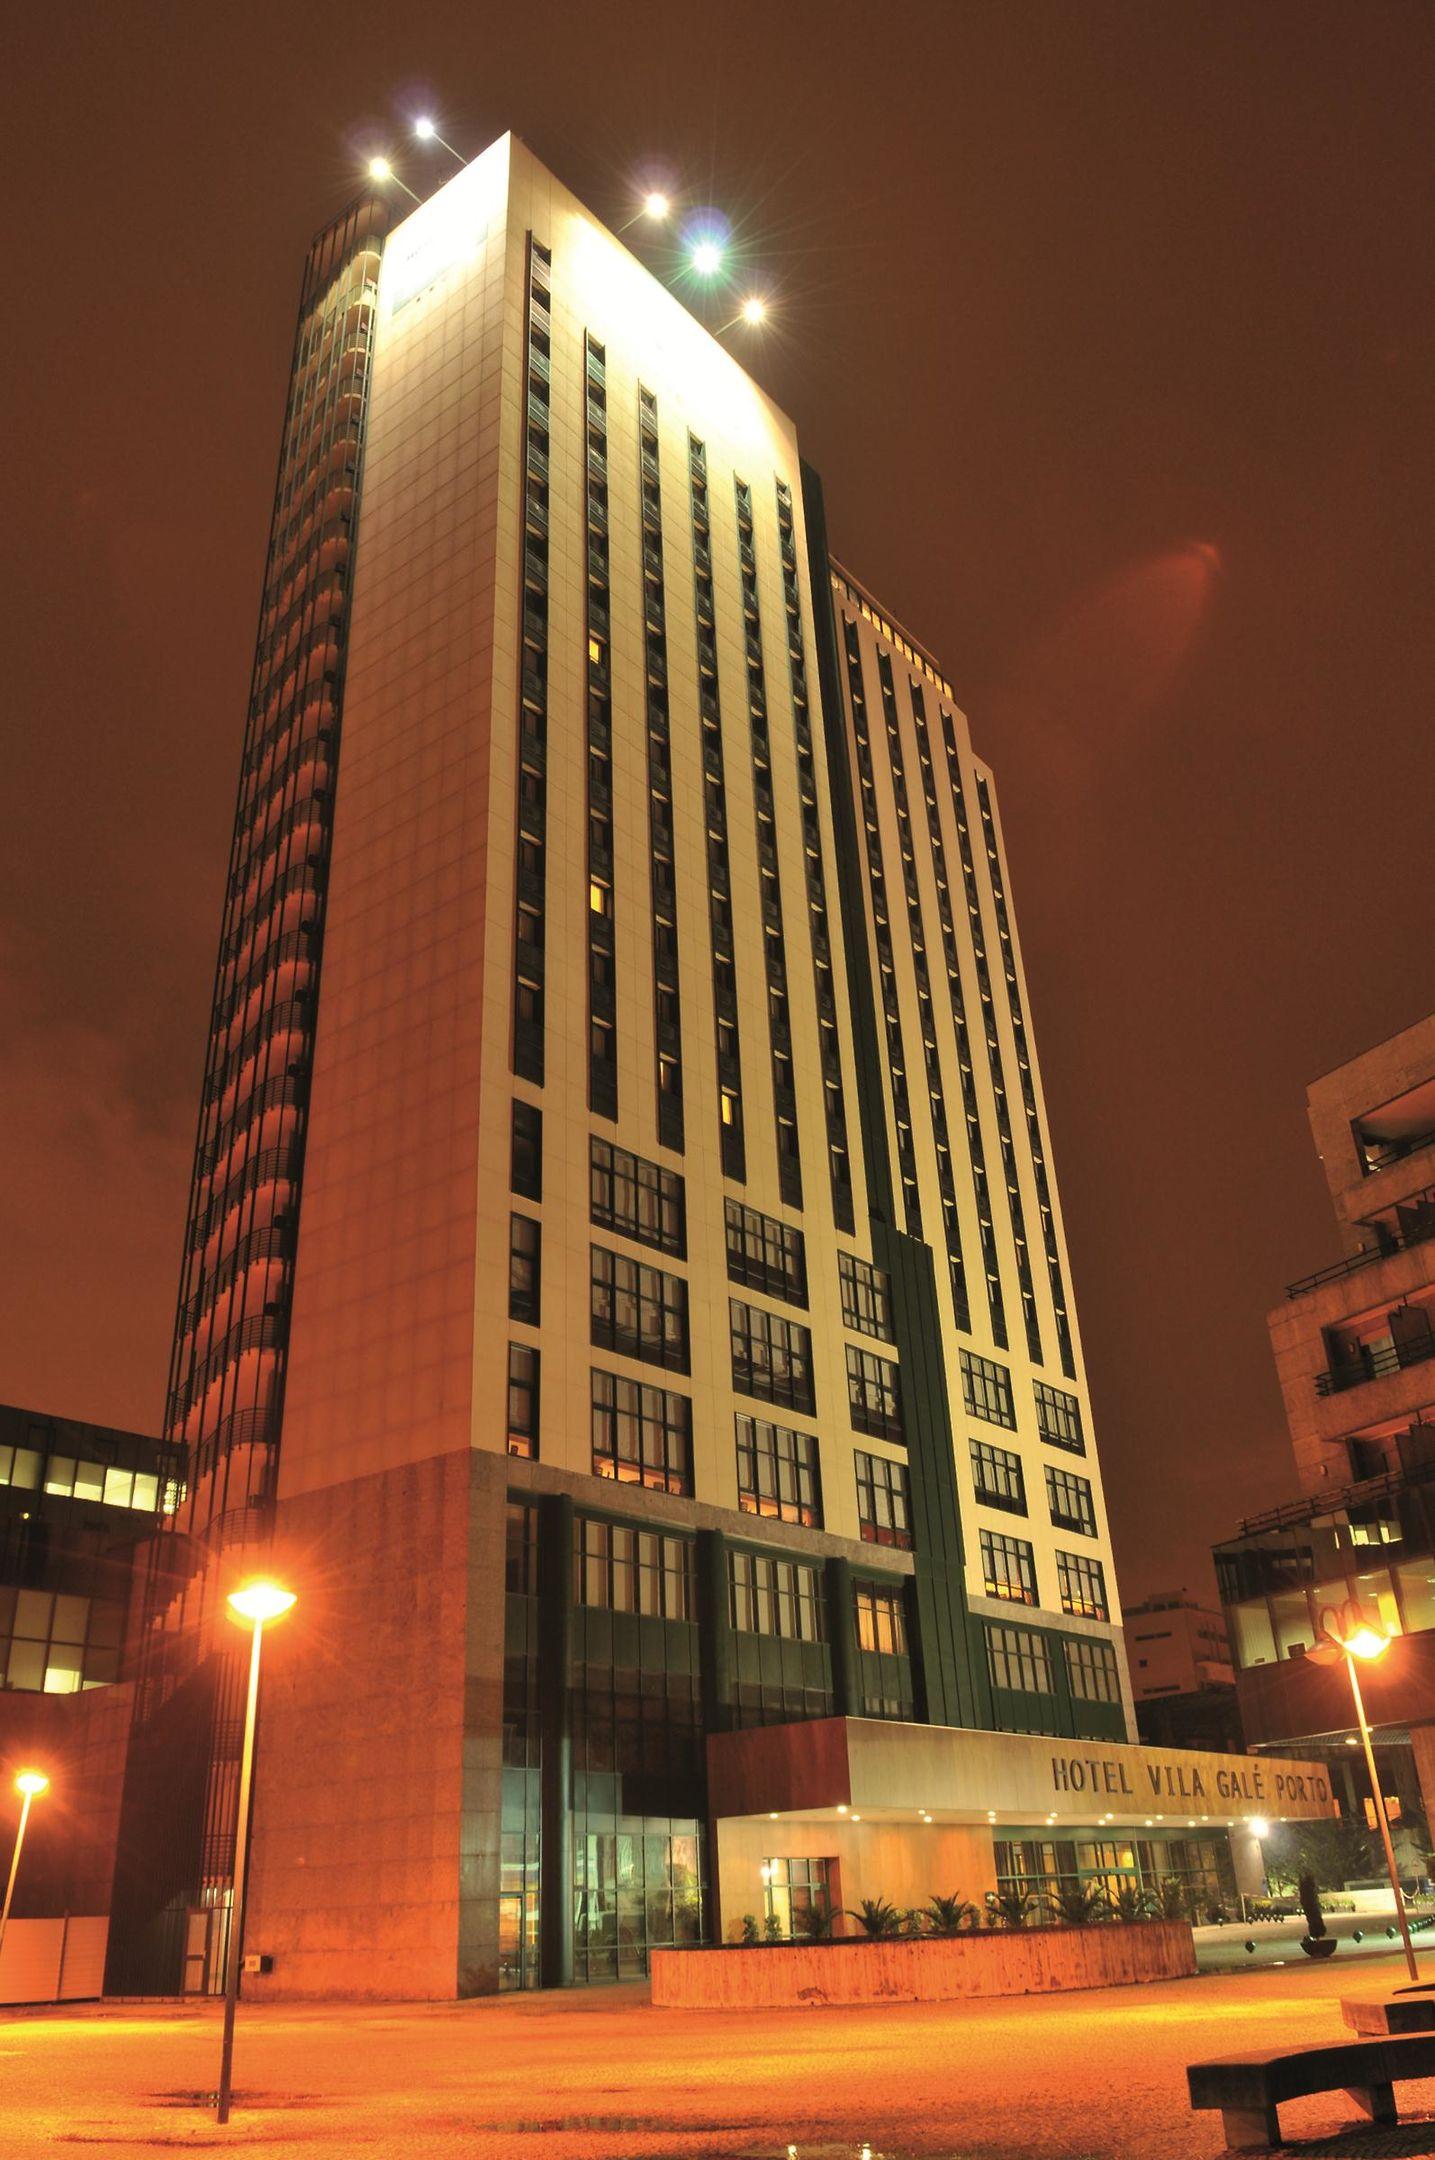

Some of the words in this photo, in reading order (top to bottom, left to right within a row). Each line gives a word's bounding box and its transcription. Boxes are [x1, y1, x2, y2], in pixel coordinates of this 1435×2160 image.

[1052, 1758, 1133, 1795] HOTEL
[1147, 1765, 1205, 1798] VILA
[1216, 1764, 1265, 1800] GALÉ
[1276, 1774, 1328, 1803] PORTO
